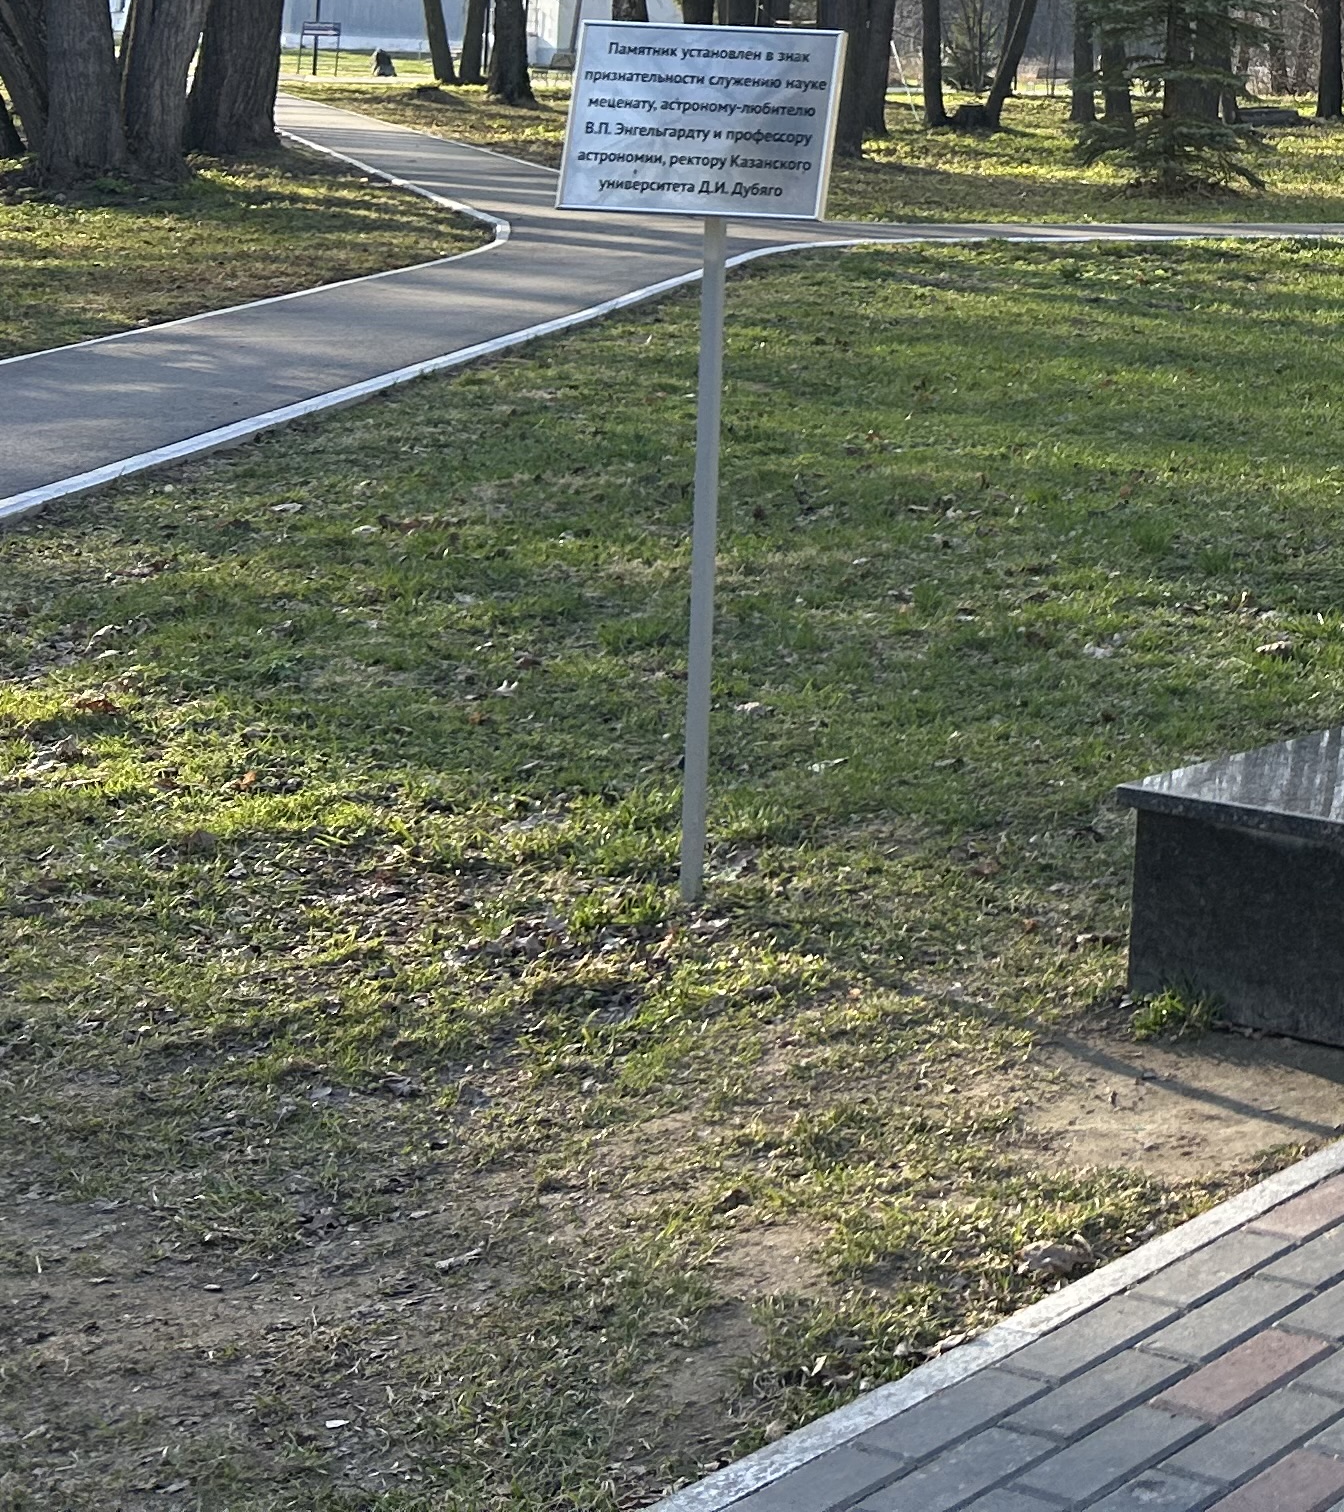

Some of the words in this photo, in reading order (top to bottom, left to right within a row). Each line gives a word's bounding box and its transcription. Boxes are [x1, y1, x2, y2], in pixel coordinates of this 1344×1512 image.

[608, 41, 677, 58] Памятник
[681, 48, 762, 61] установлен
[765, 52, 773, 61] в
[777, 51, 810, 63] знак
[584, 70, 705, 85] признательности
[709, 76, 782, 90] служению
[786, 79, 827, 92] науке
[588, 97, 658, 112] меценату,
[661, 98, 816, 117] астроному-любителю
[585, 121, 612, 135] В.П.
[615, 122, 709, 140] Энгельгардту
[713, 131, 721, 139] и
[726, 130, 812, 145] профессору
[577, 150, 666, 166] астрономии,
[669, 154, 727, 170] ректору
[730, 155, 811, 172] Казанского
[598, 178, 695, 194] университета
[698, 180, 728, 196] Д.И.
[731, 181, 783, 199] Дубяго
